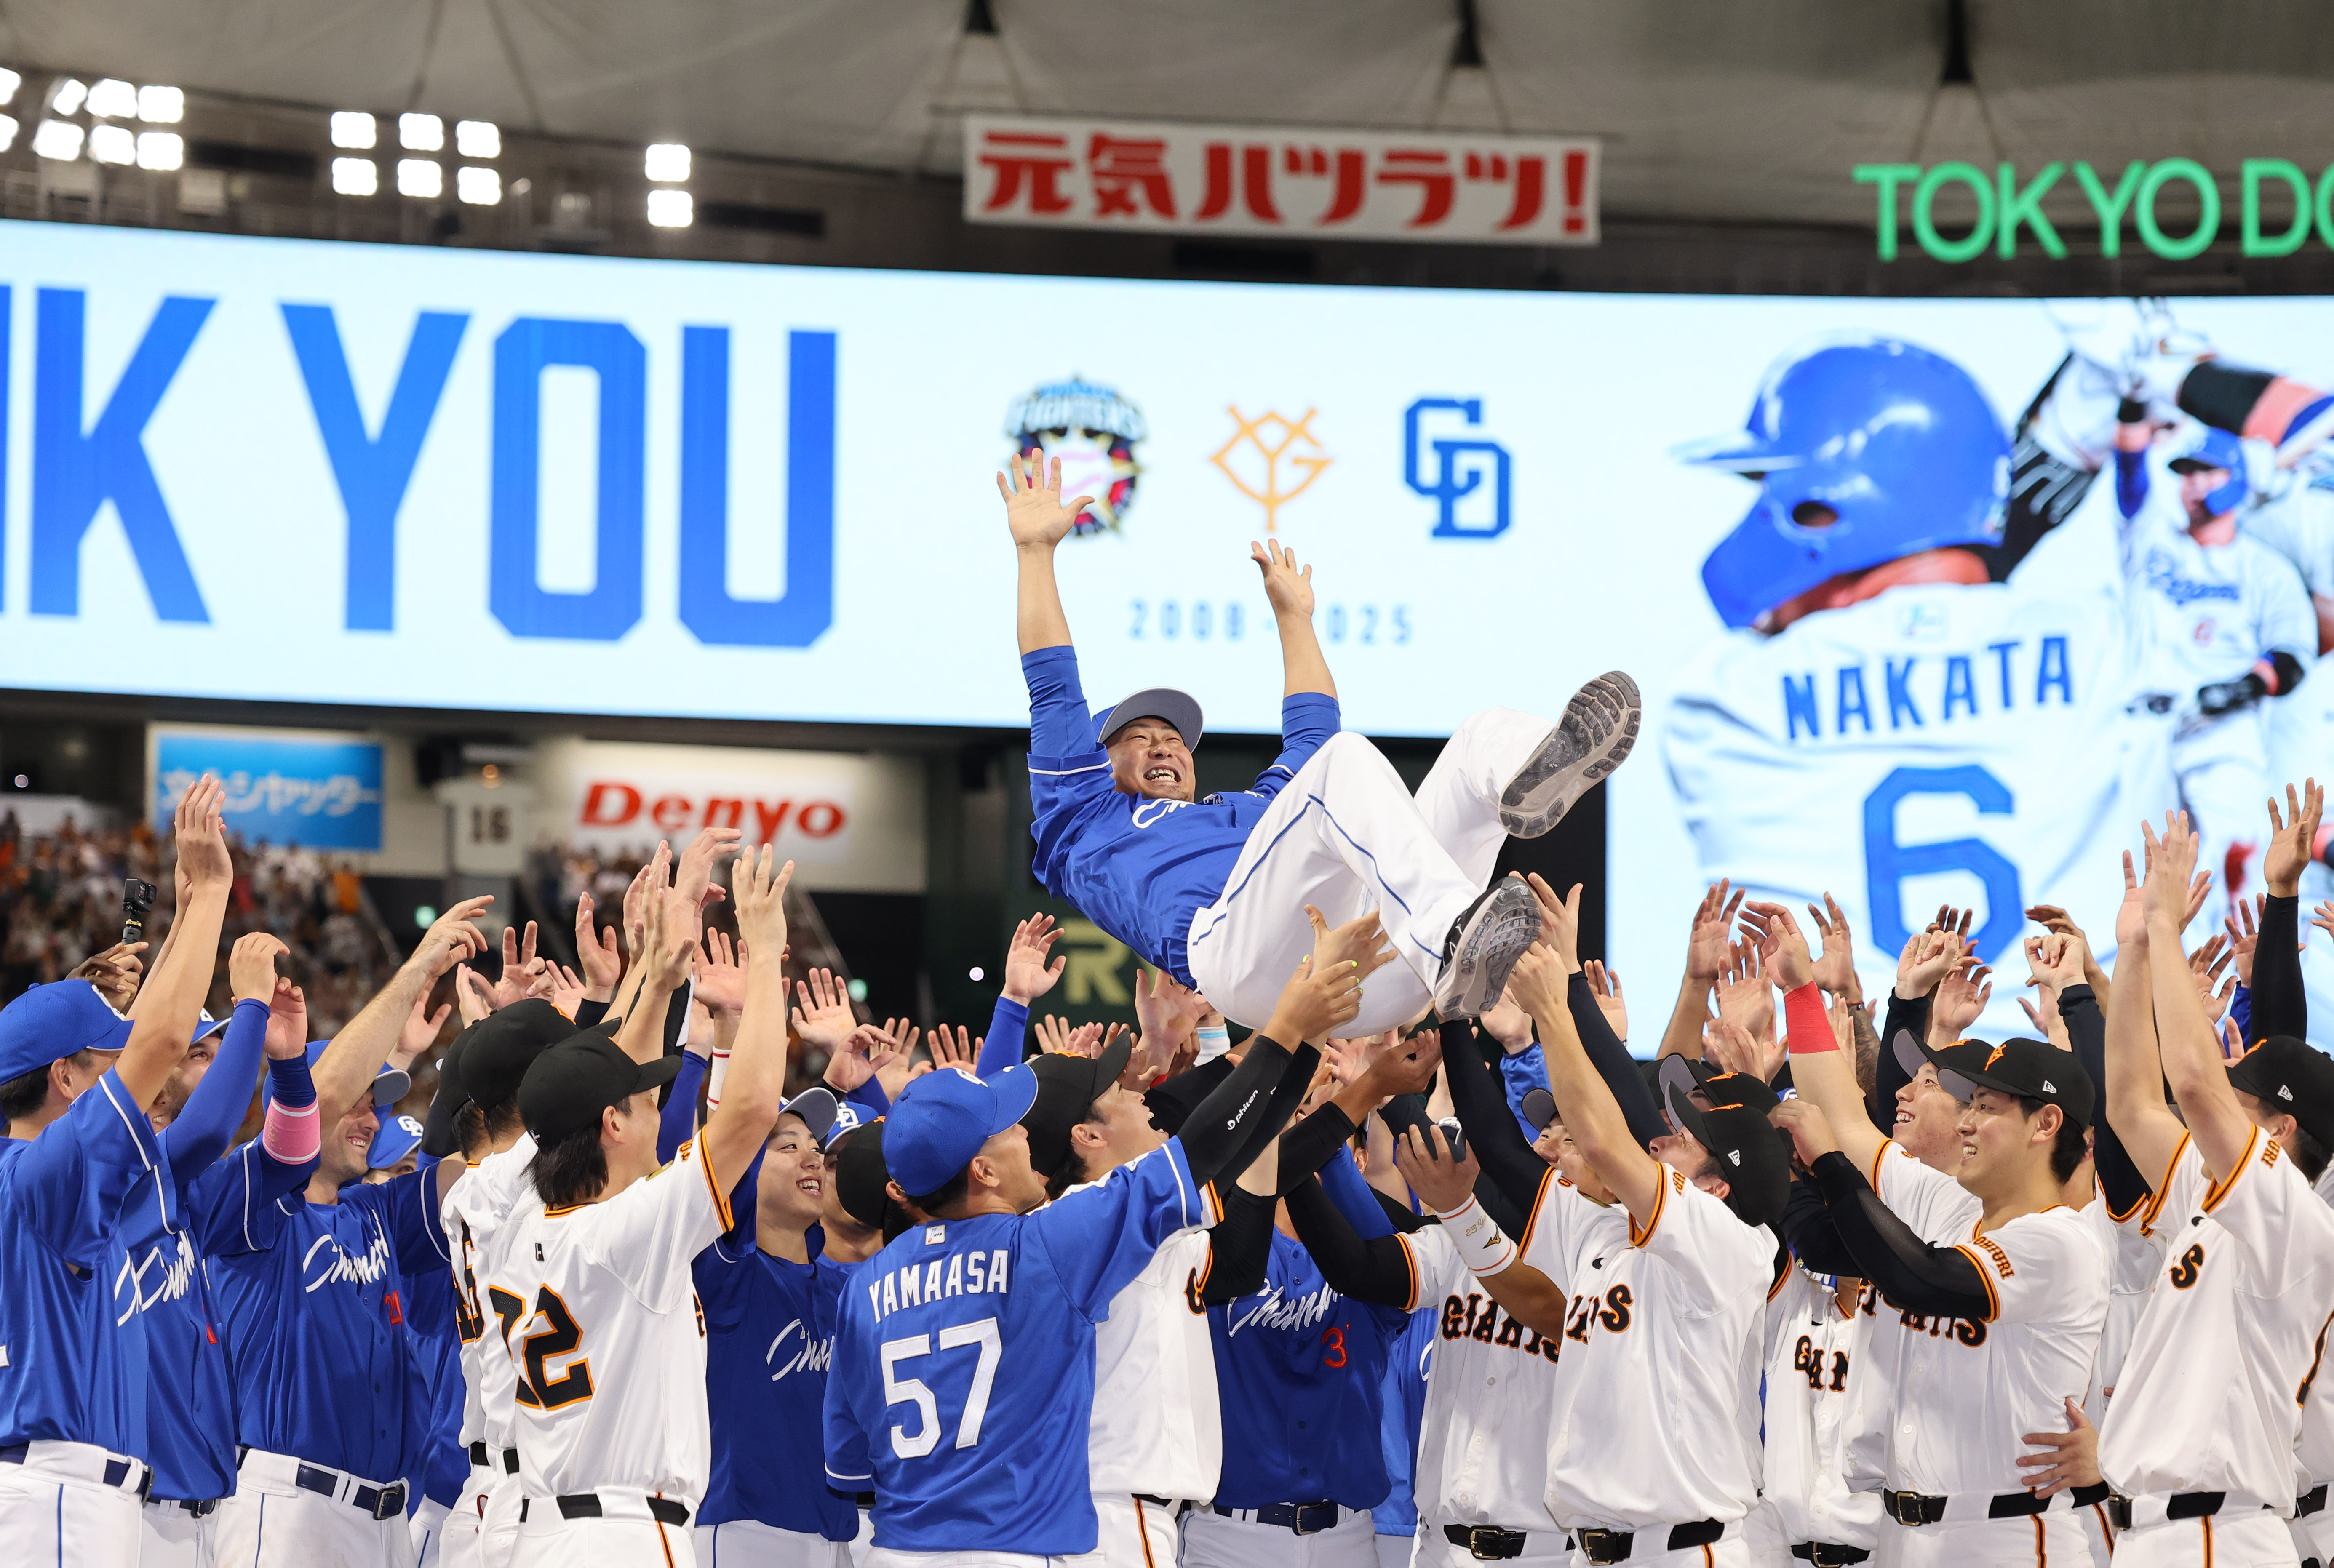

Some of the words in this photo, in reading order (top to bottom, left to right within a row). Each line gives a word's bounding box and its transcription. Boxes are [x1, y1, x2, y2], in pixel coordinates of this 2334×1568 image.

[1853, 157, 2222, 263] TOKYO
[2241, 157, 2334, 258] D
[0, 283, 219, 624] K
[276, 300, 838, 649] YOU
[1783, 636, 2074, 741] NAKATA
[580, 781, 844, 847] Denyo
[1863, 764, 2024, 965] 6
[1235, 1089, 1258, 1124] phiten
[868, 1249, 1009, 1324] YAMAASA
[881, 1316, 1002, 1460] 57
[1322, 1323, 1350, 1369] 3
